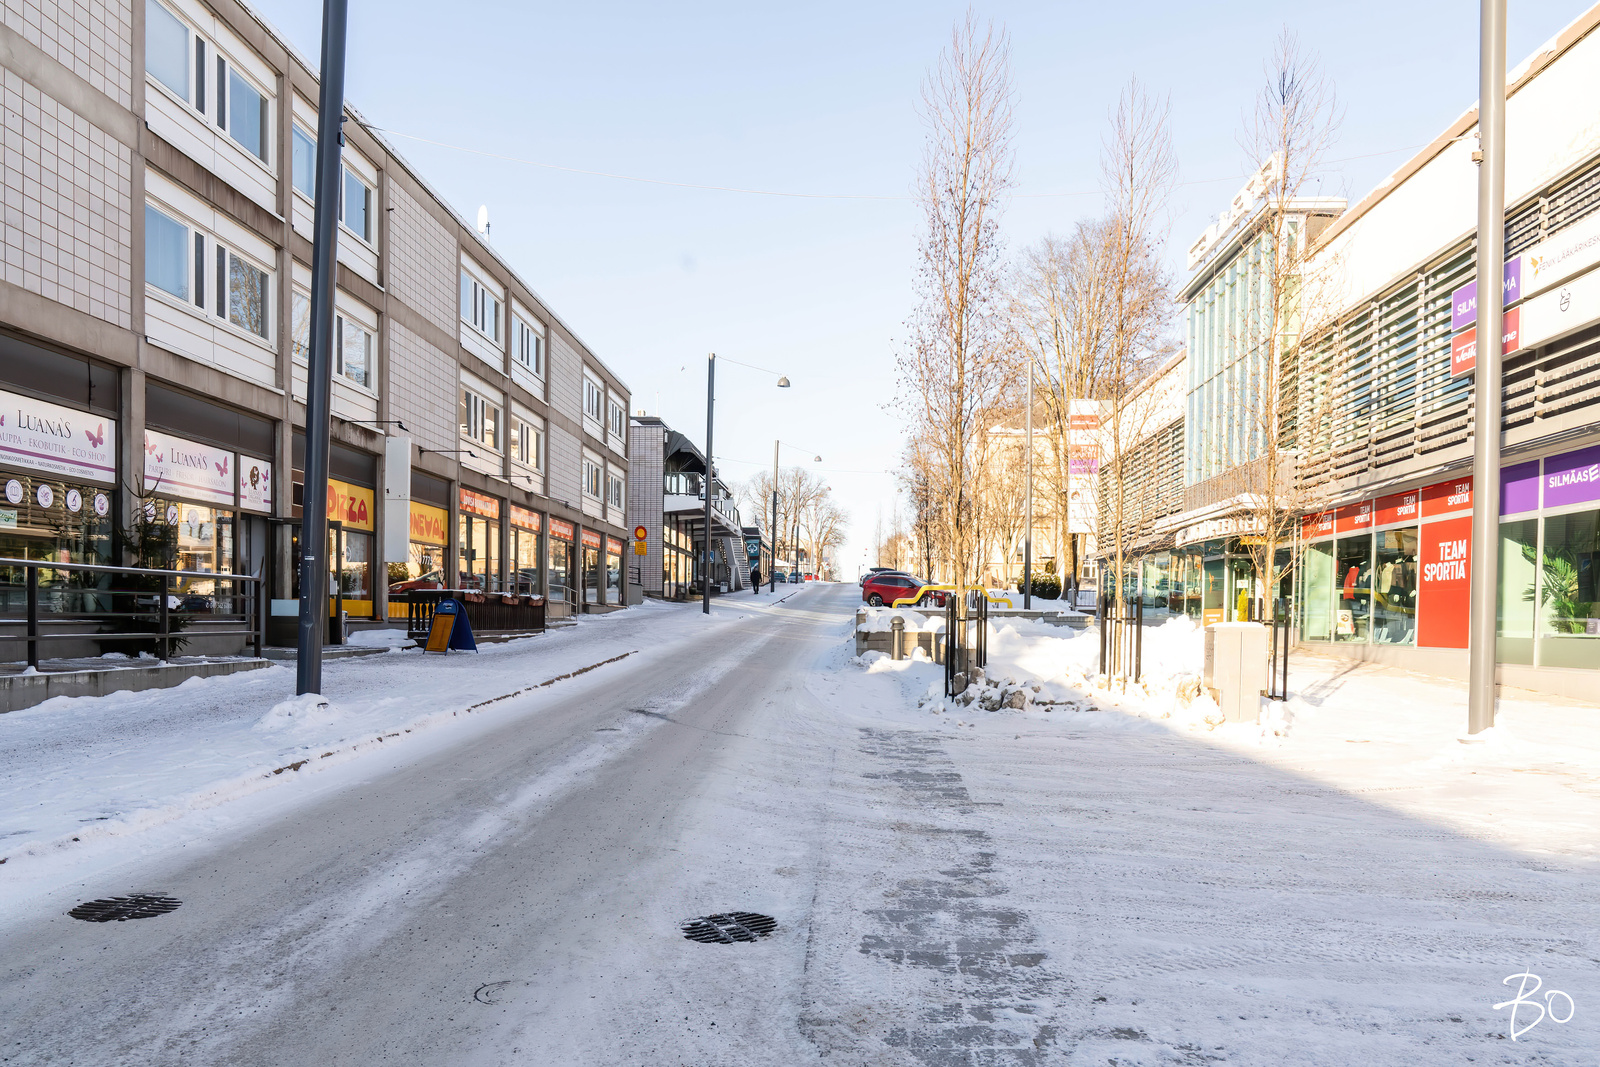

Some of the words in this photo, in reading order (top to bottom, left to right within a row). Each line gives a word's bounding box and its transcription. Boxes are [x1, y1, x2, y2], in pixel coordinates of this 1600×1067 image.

[29, 438, 66, 455] EKOBUTIK
[72, 447, 86, 458] ECO
[88, 451, 106, 462] SHOP
[1549, 464, 1600, 488] SILMÄASE
[1455, 483, 1470, 494] TEAM
[327, 484, 368, 525] PIZZA
[1403, 495, 1416, 506] TEAM
[1447, 492, 1470, 506] SPORTIA
[1354, 513, 1370, 524] SPORTIA
[1360, 505, 1370, 515] TEAM
[1397, 504, 1416, 516] SPORTIA
[410, 512, 445, 540] NEVAL
[1438, 539, 1467, 561] TEAM
[1424, 560, 1467, 582] SPORTIA
